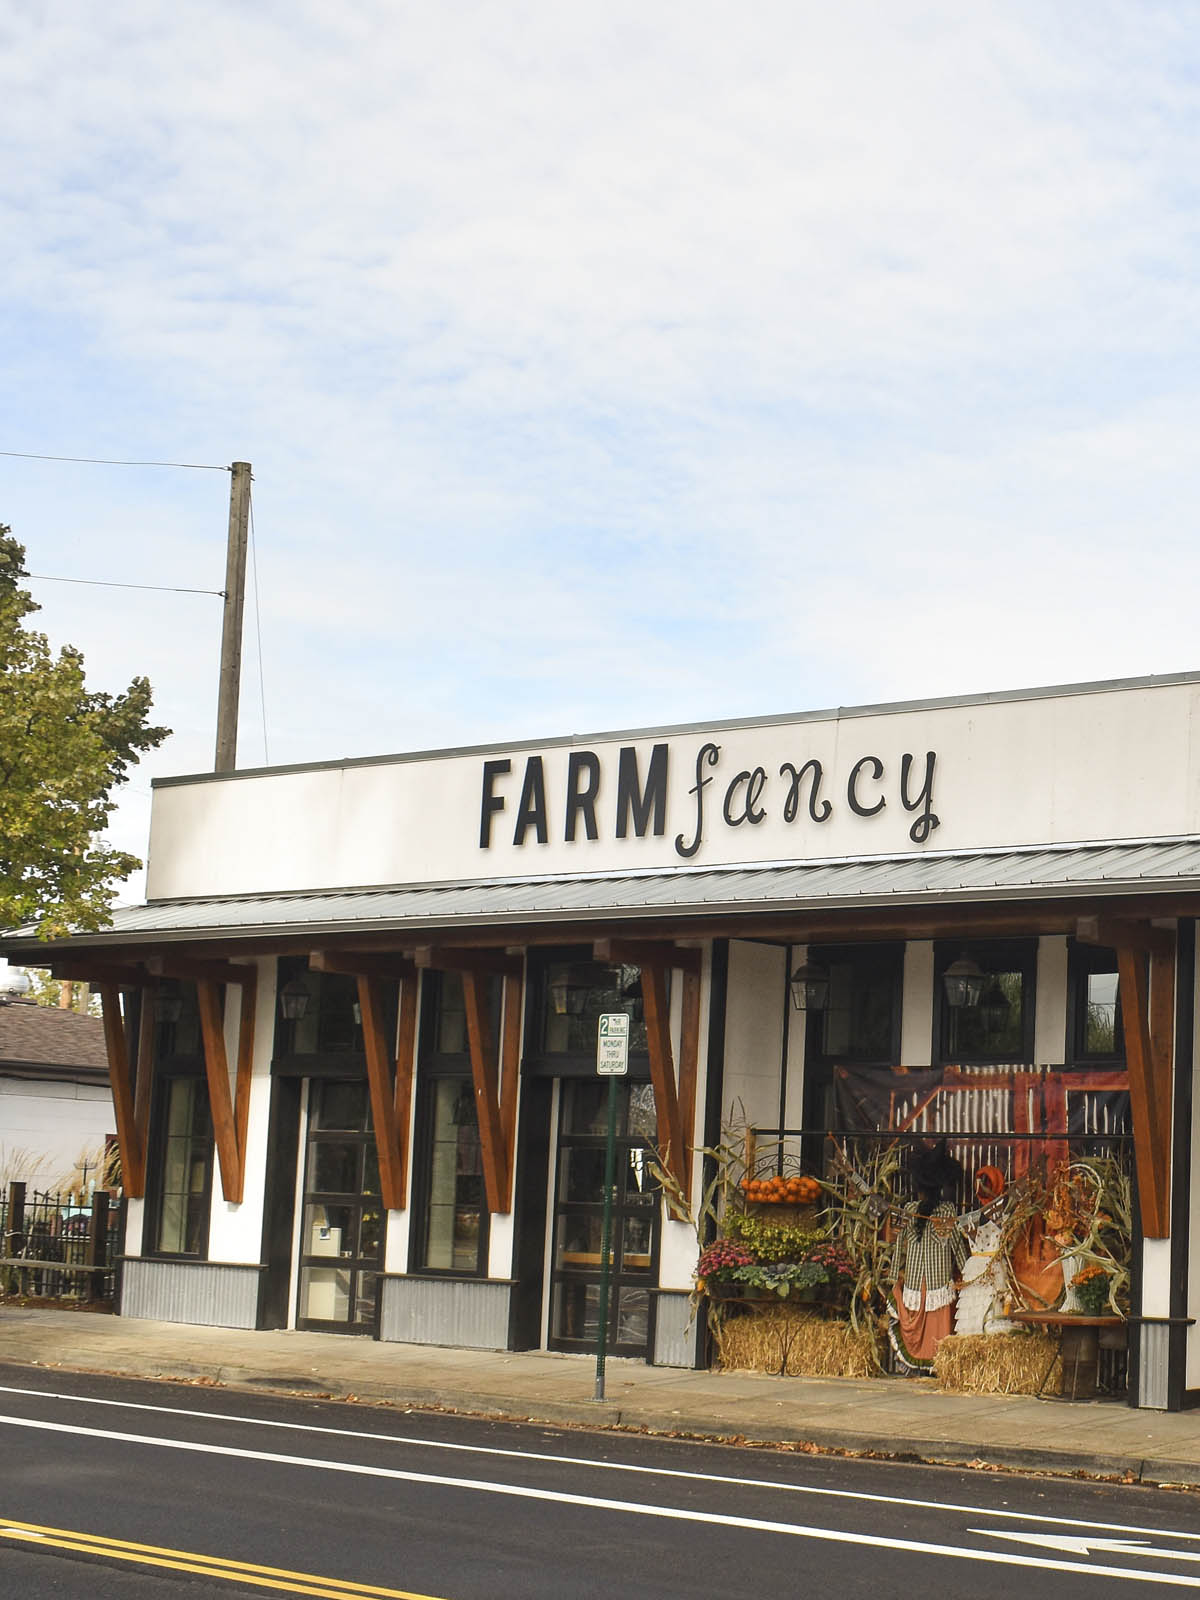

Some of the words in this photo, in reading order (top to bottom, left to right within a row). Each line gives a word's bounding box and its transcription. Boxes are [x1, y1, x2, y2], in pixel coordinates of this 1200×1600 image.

[601, 1018, 609, 1035] 2
[603, 1039, 623, 1048] MONDAY
[606, 1050, 619, 1058] THRU
[600, 1060, 624, 1069] SATURDAY
